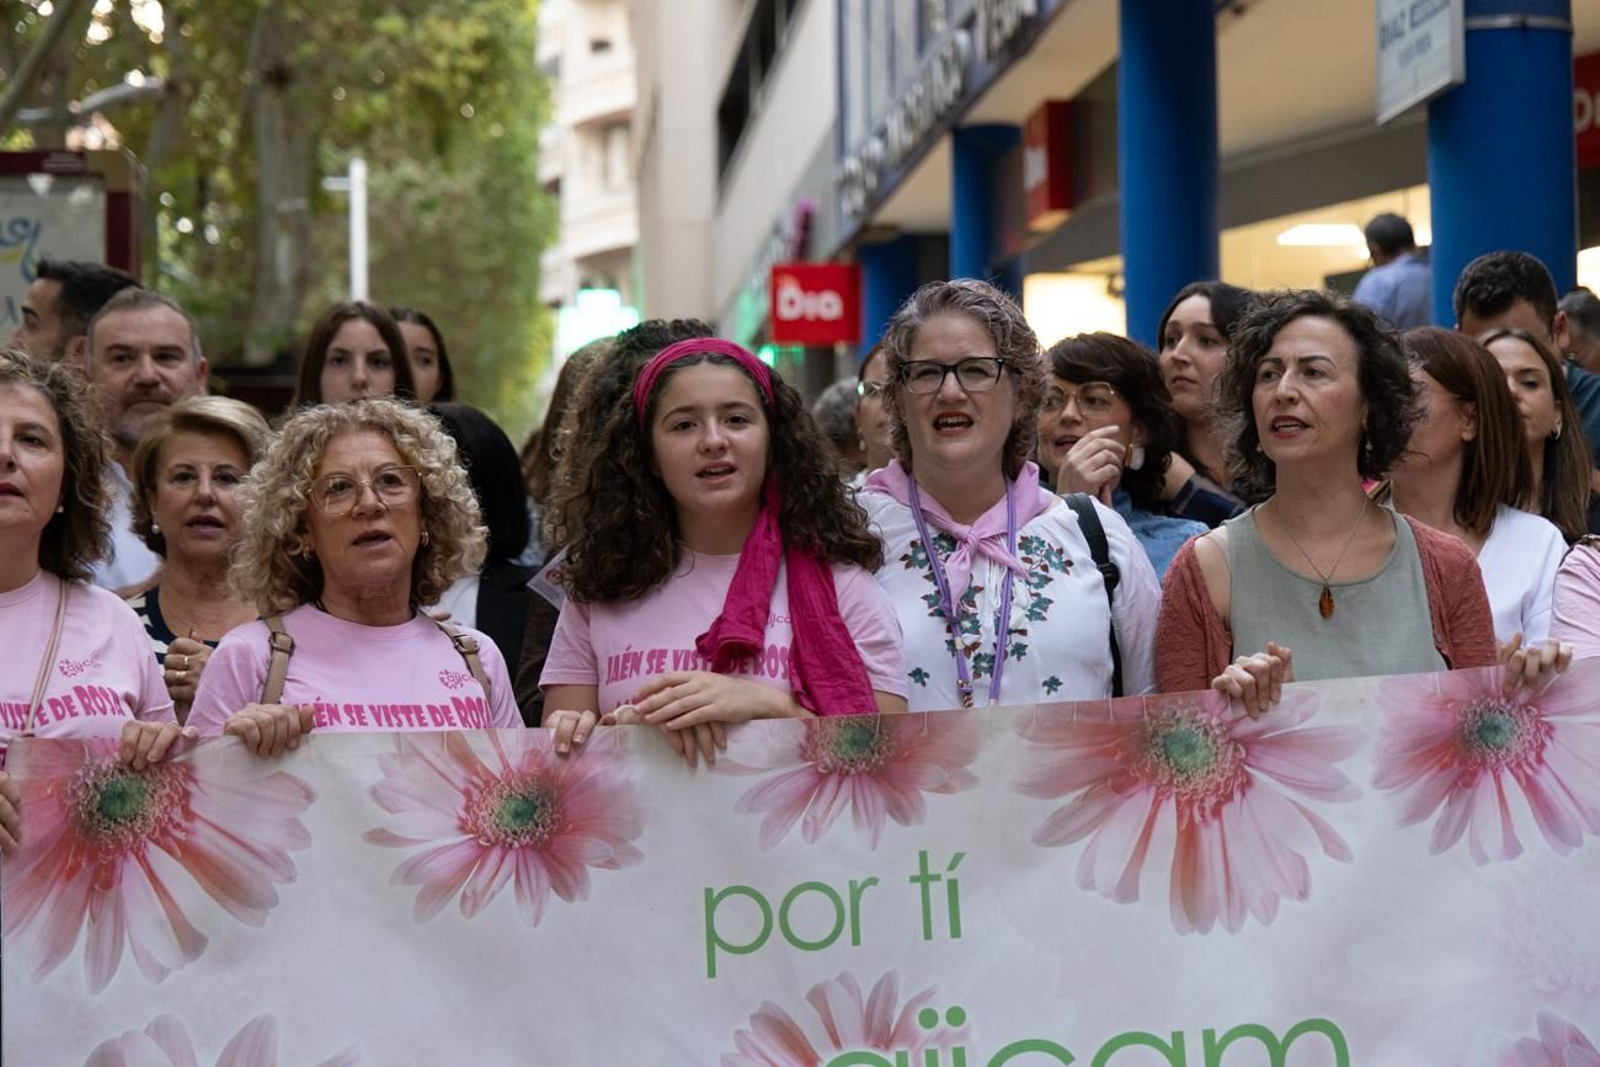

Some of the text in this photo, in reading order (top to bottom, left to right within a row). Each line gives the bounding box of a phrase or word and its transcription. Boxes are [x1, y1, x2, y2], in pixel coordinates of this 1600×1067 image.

[605, 644, 645, 685] JAÉN
[646, 648, 669, 678] SE
[752, 644, 790, 680] ROS
[47, 694, 79, 722] DE
[72, 685, 126, 717] ROSA
[343, 704, 368, 727] SE
[369, 704, 425, 728] VISTE
[426, 704, 456, 729] DE
[704, 850, 966, 978] por tí
